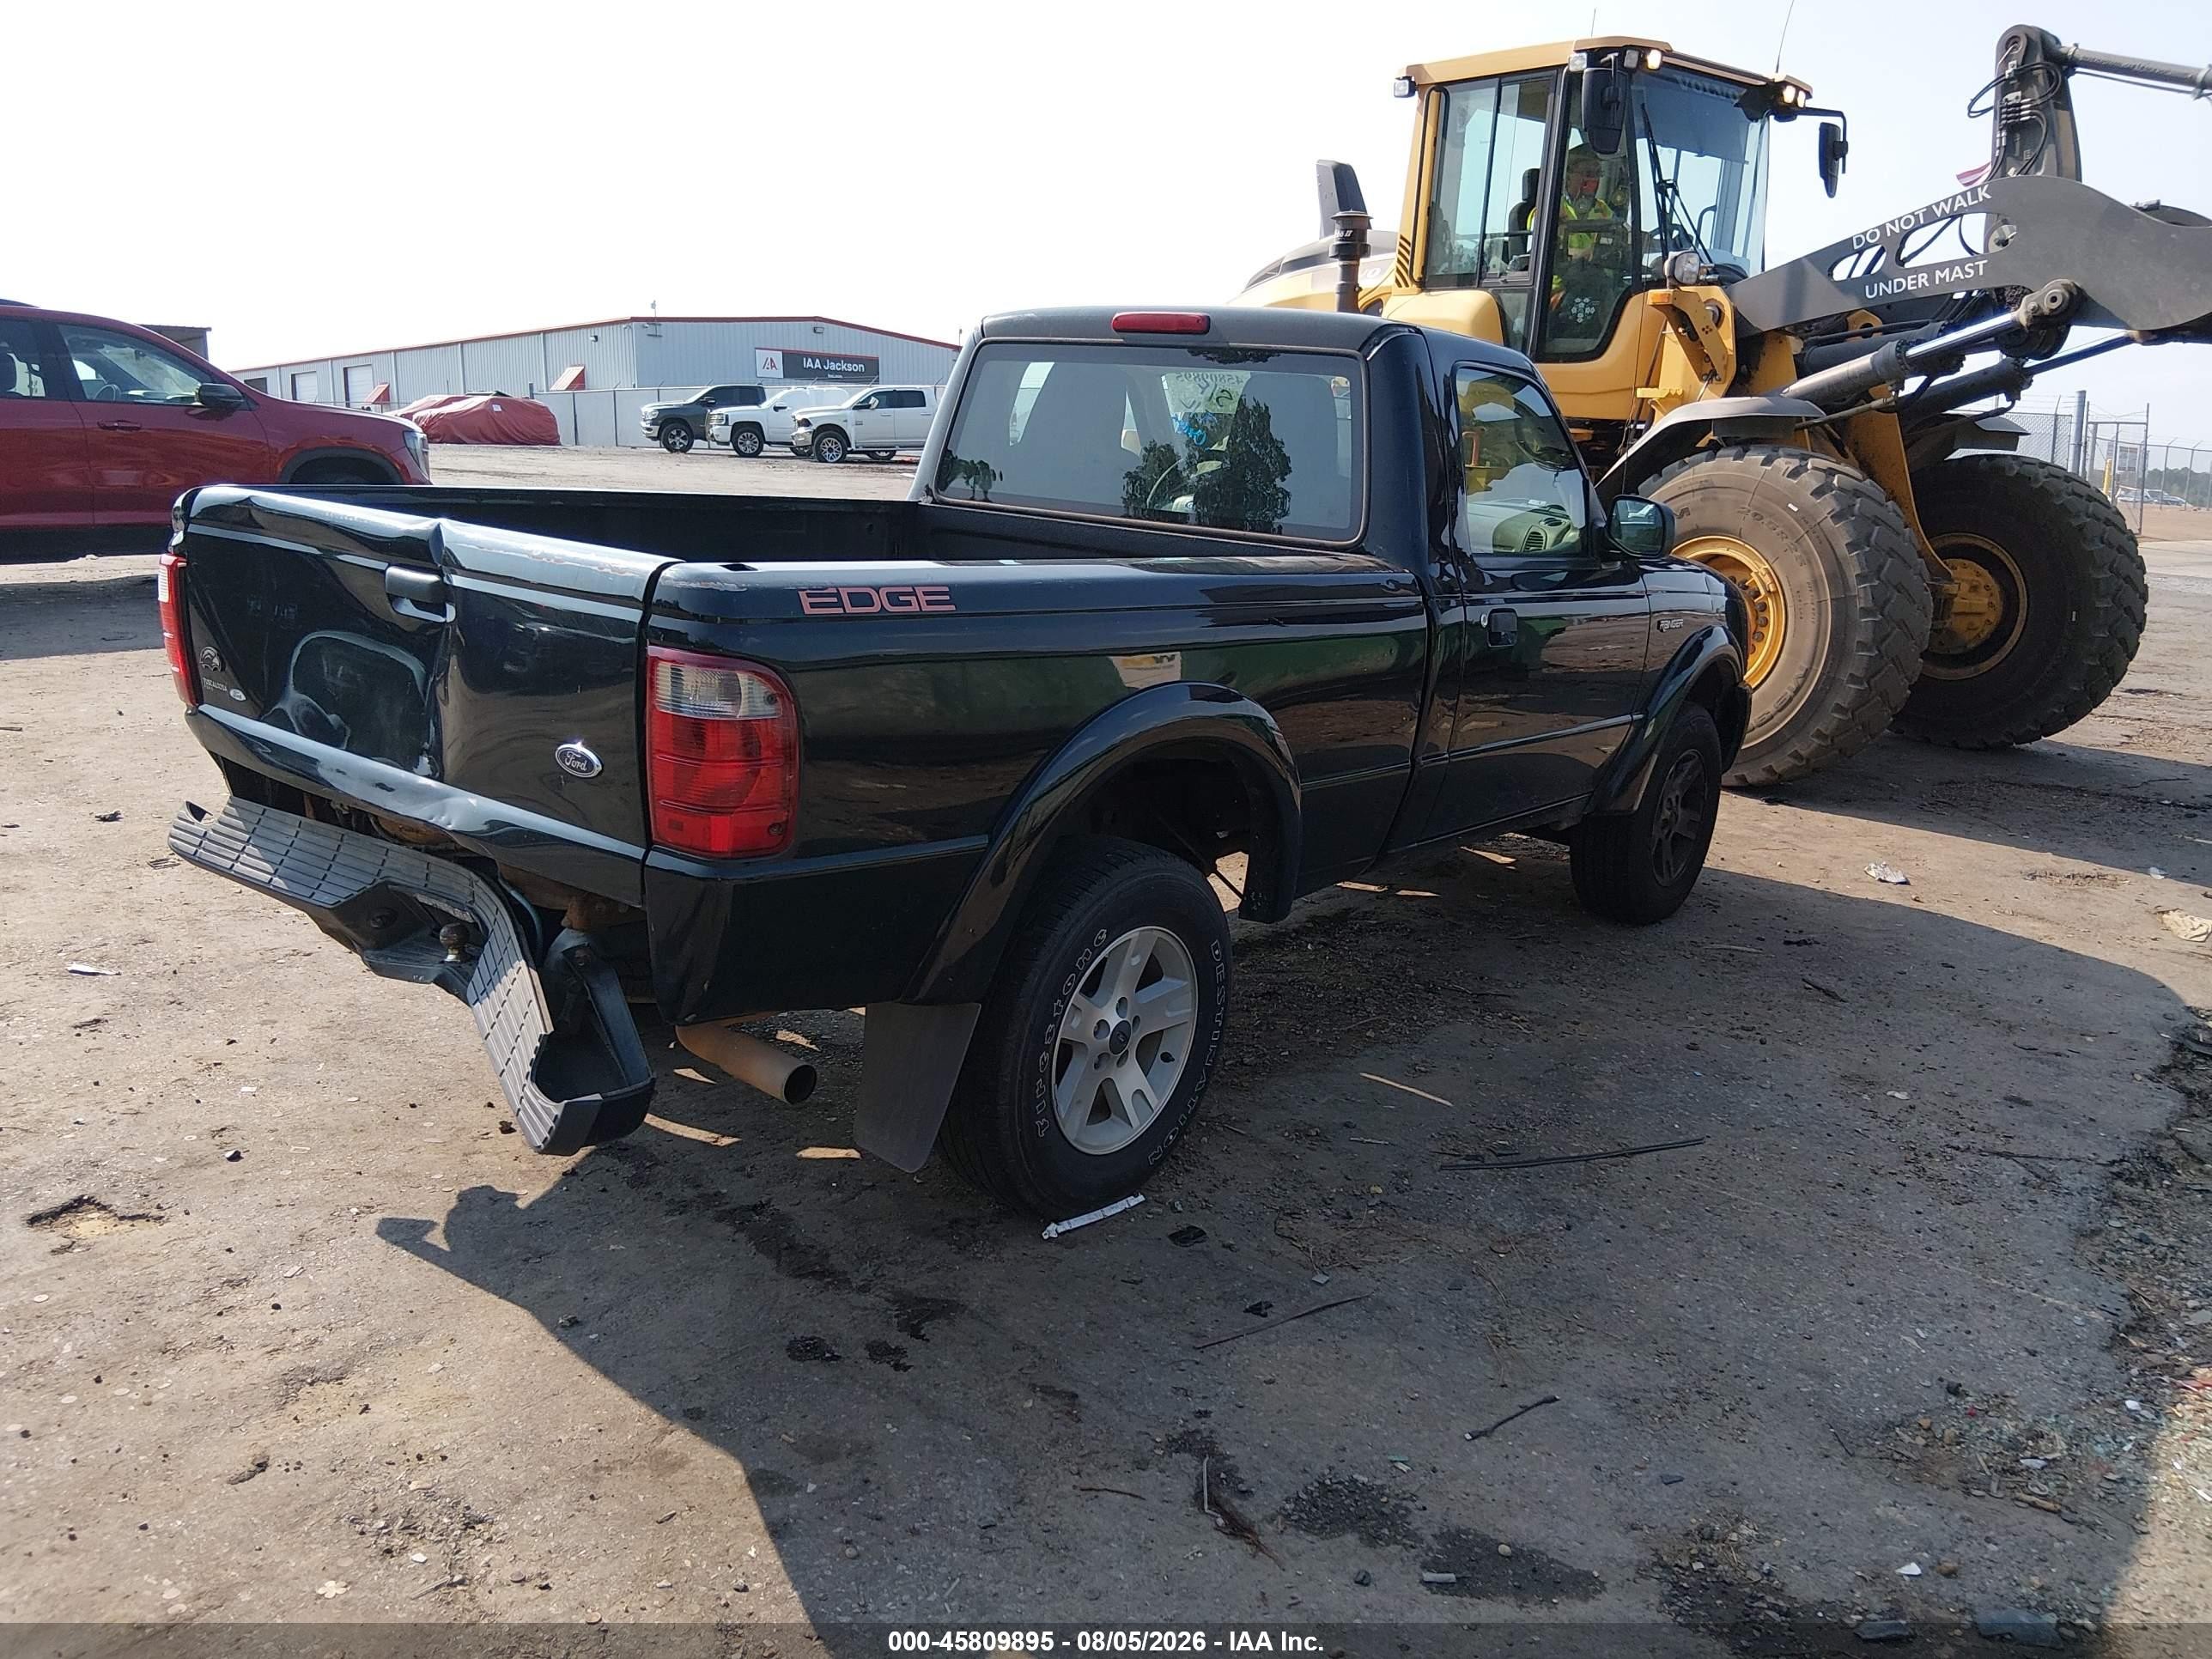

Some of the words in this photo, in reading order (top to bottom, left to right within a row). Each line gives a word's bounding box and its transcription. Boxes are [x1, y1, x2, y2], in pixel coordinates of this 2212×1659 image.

[1852, 228, 1881, 250] DO
[1886, 209, 1927, 237] NOT
[1932, 184, 1992, 218] WALK
[1865, 272, 1929, 299] UNDER
[1935, 259, 1988, 285] MAST
[803, 357, 822, 369] IAA
[823, 358, 865, 373] Jackson
[798, 586, 957, 615] EDGE
[564, 750, 587, 771] Ford
[1147, 939, 1225, 1166] DESTINATION
